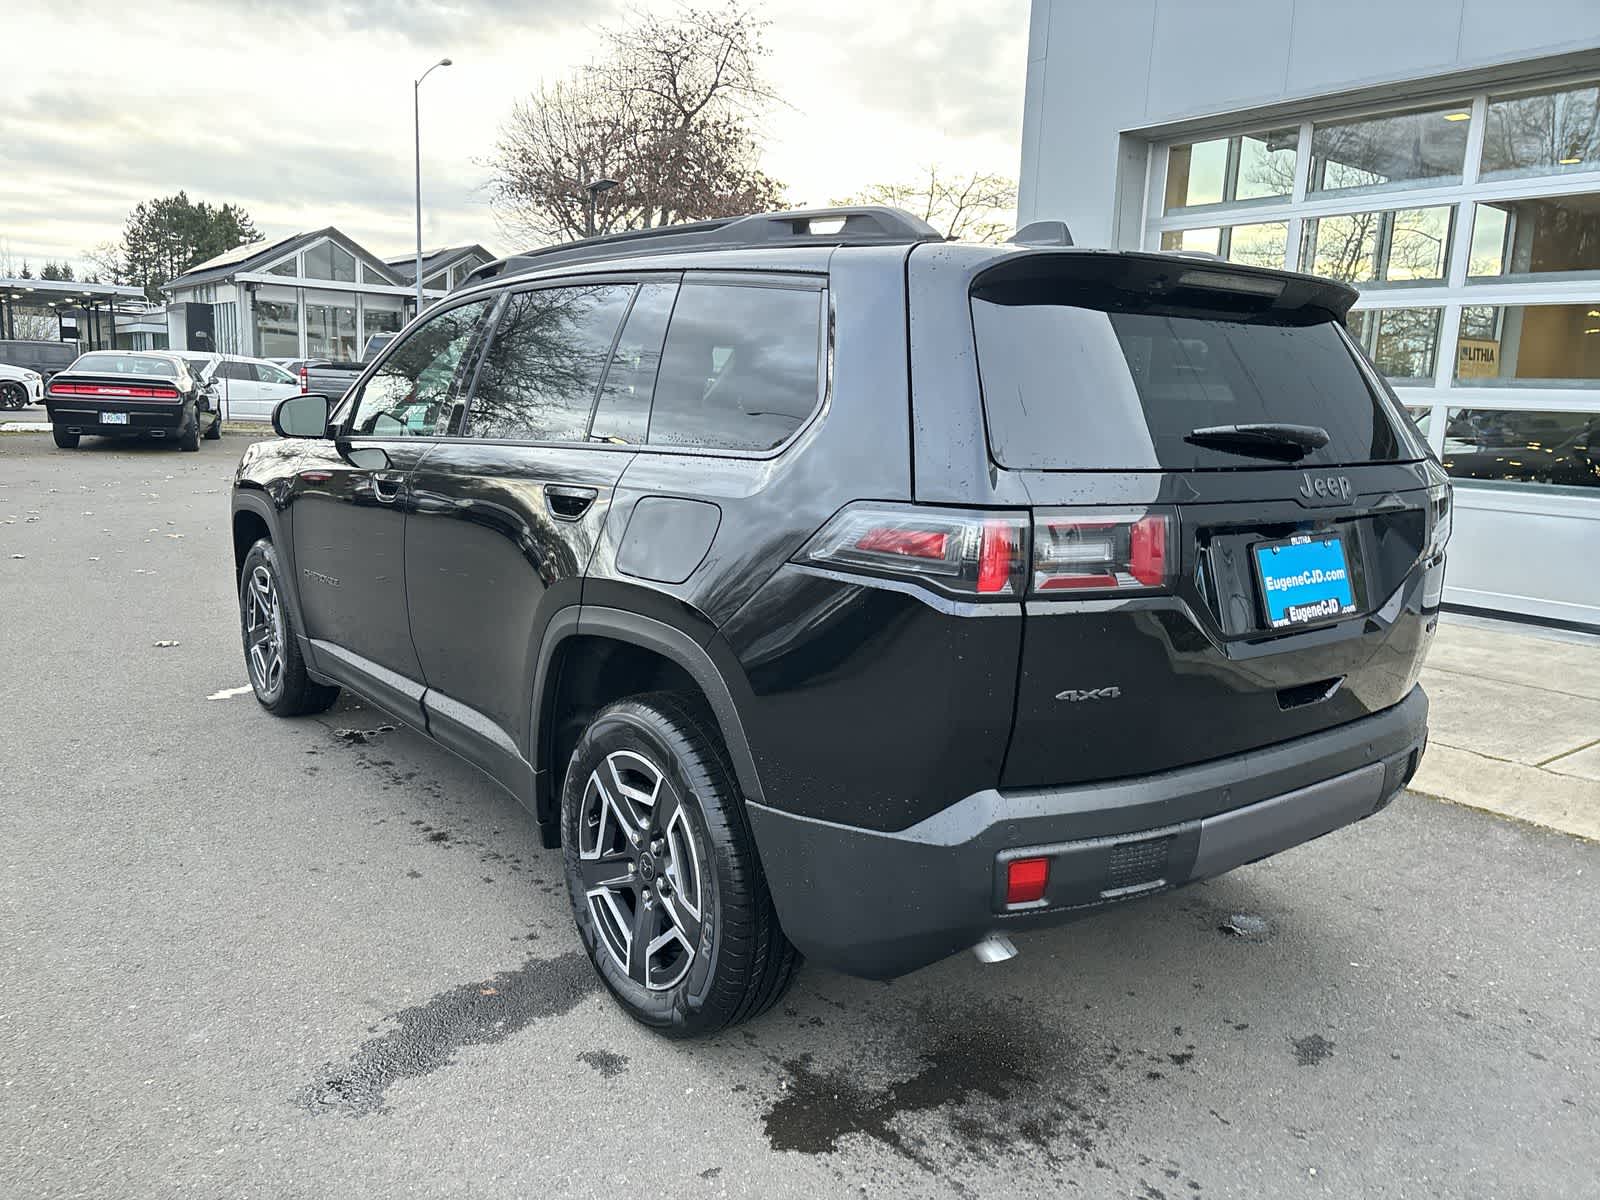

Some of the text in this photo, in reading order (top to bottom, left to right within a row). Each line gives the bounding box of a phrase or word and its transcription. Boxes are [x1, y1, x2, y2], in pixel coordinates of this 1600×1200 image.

[1468, 347, 1495, 362] LITHIA
[1300, 472, 1351, 500] Jeep
[1265, 568, 1345, 591] EugeneCJD.com
[1289, 598, 1338, 623] EugeneCJD
